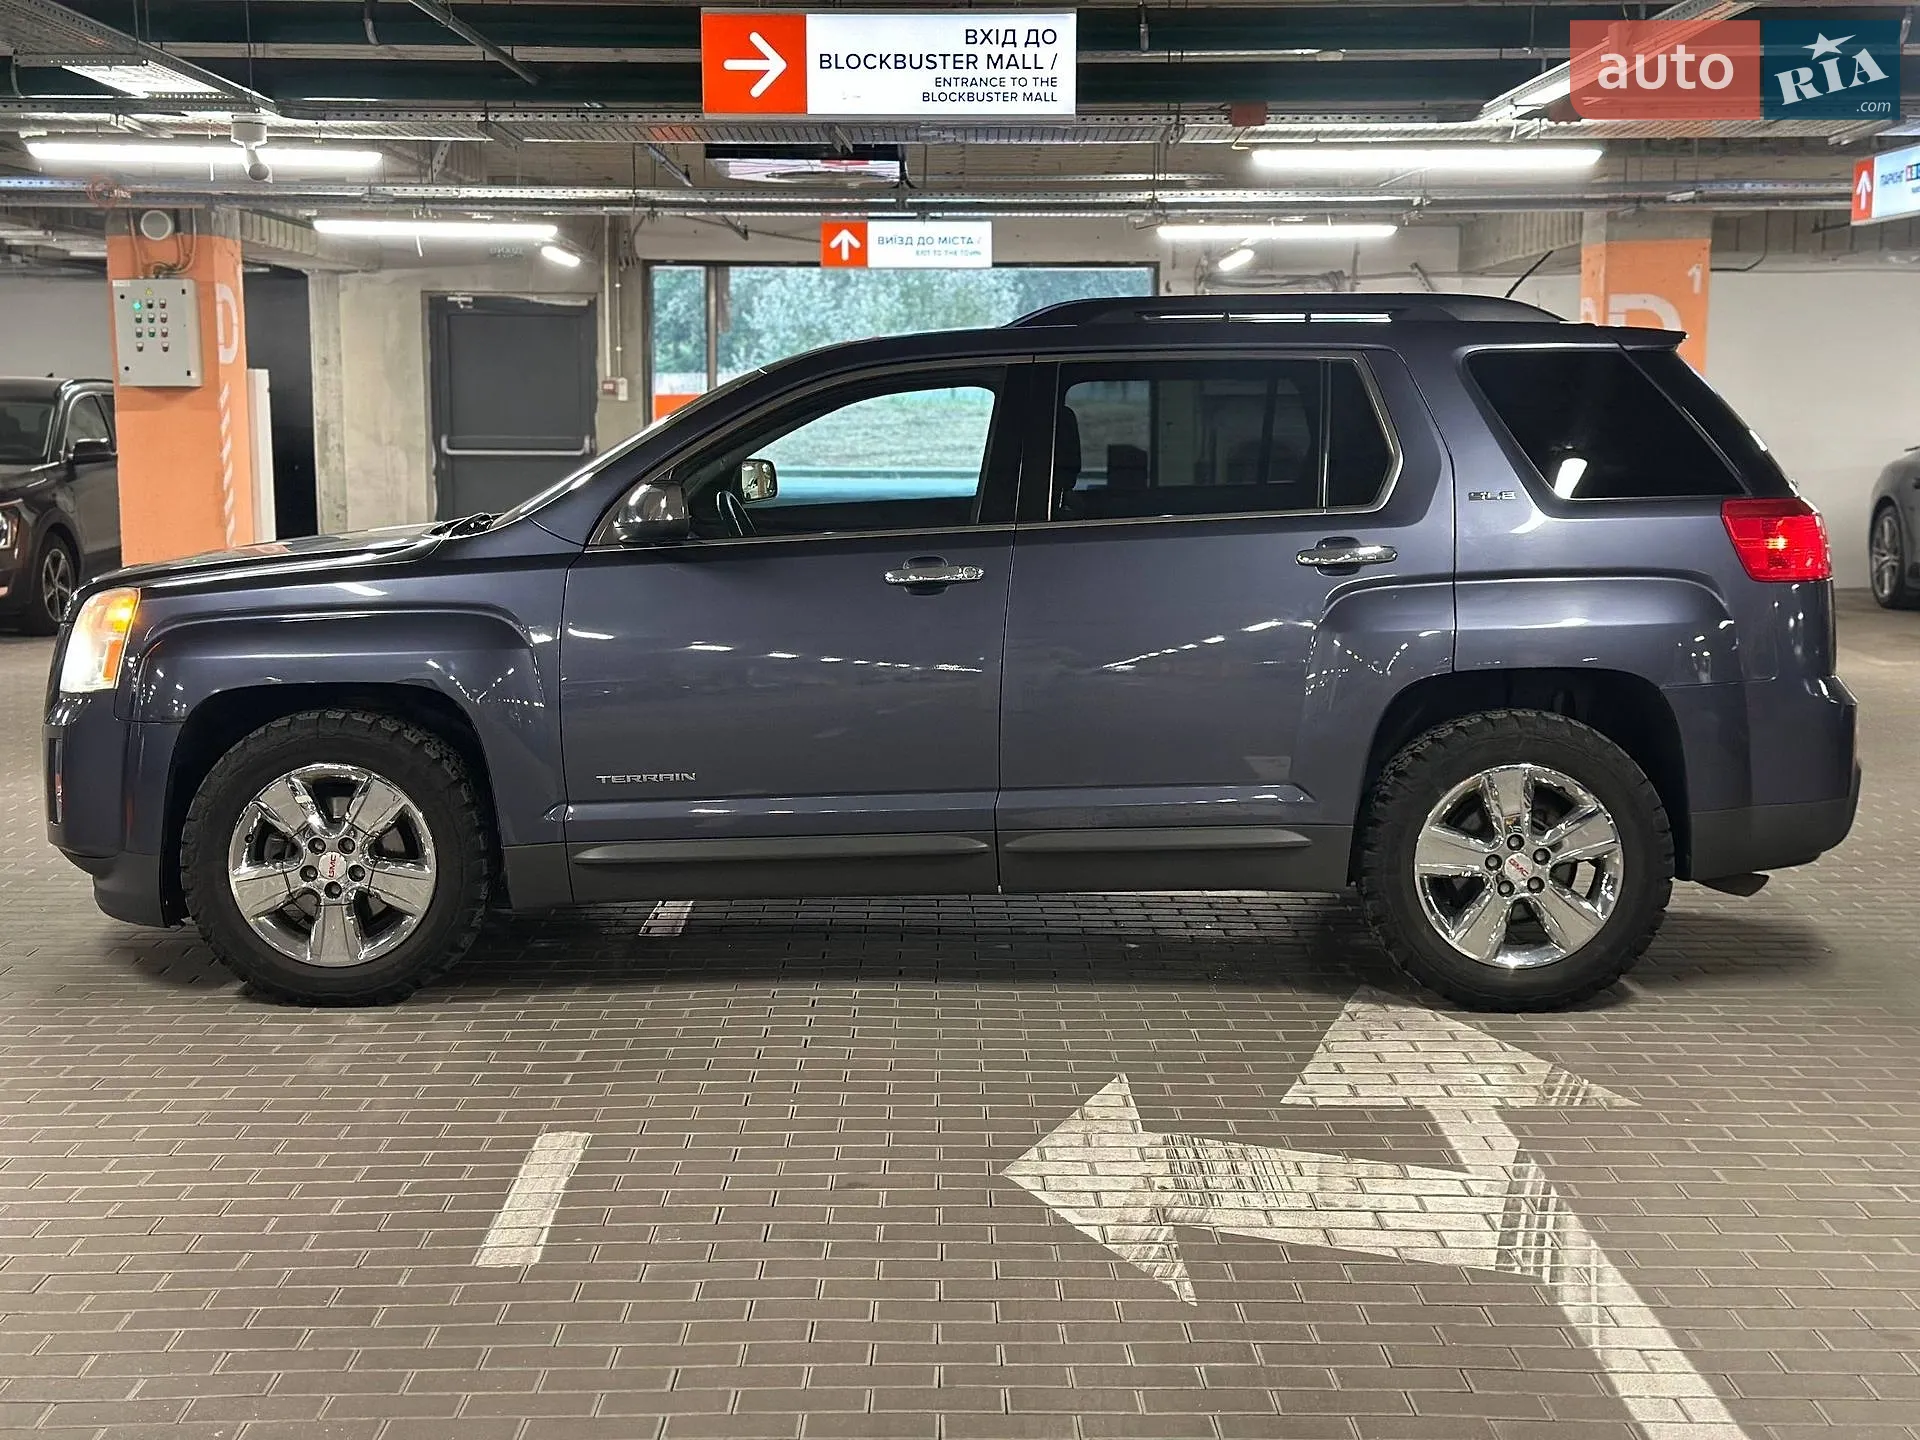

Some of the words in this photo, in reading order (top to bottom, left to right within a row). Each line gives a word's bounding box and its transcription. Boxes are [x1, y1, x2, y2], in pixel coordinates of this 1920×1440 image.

[965, 29, 1017, 47] ВХІД
[1024, 29, 1057, 47] ДО
[819, 53, 978, 70] BLOCKBUSTER
[986, 53, 1044, 70] MALL
[1050, 53, 1058, 70] /
[934, 77, 1006, 88] ENTRANCE
[1011, 77, 1028, 88] TO
[1033, 77, 1058, 88] THE
[922, 92, 1018, 102] BLOCKBUSTER
[1022, 92, 1058, 102] MALL
[877, 235, 914, 246] ВИЇЗД
[917, 236, 934, 246] ДО
[938, 236, 974, 245] МІСТА
[1687, 264, 1703, 294] 1
[215, 283, 239, 364] D
[1468, 490, 1517, 501] SLE
[595, 772, 696, 784] TERRAIN
[328, 854, 337, 878] GMC
[1508, 858, 1529, 877] GMC
